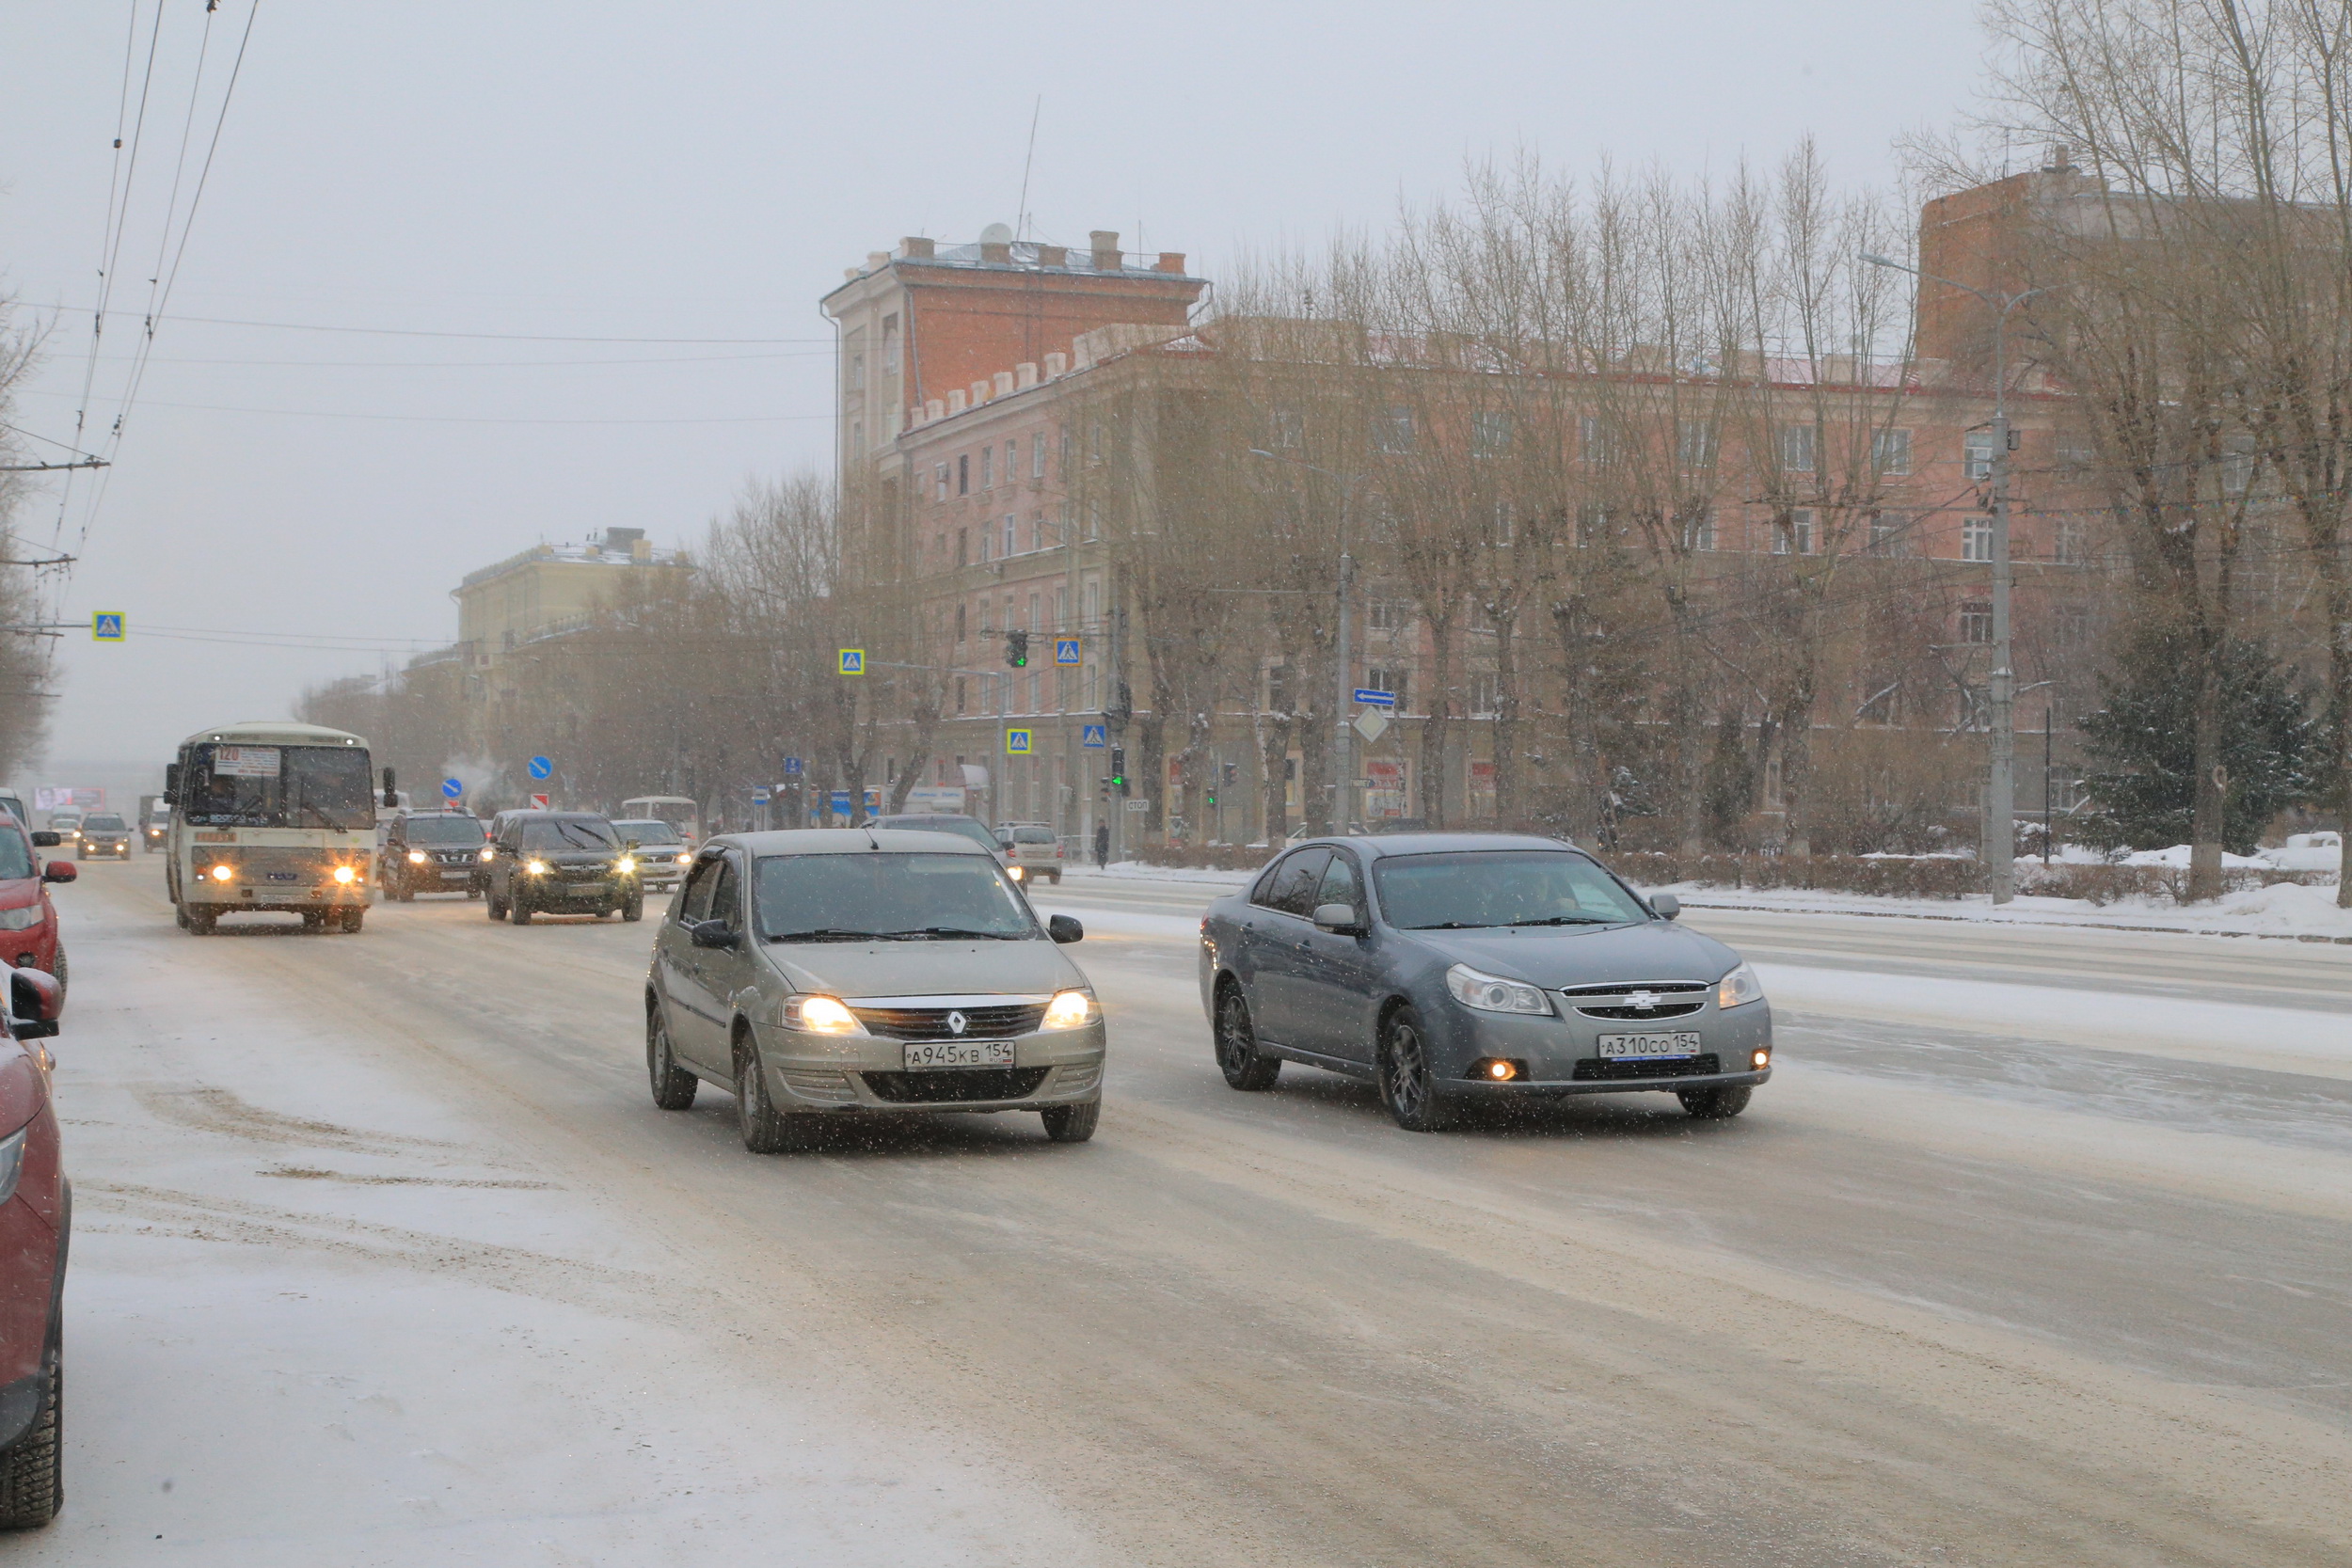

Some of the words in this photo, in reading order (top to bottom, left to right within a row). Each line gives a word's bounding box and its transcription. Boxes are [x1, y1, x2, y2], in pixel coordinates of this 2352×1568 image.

[219, 746, 239, 761] 120
[1128, 800, 1148, 810] СТОП
[1673, 1034, 1698, 1048] 154
[985, 1043, 1010, 1057] 154
